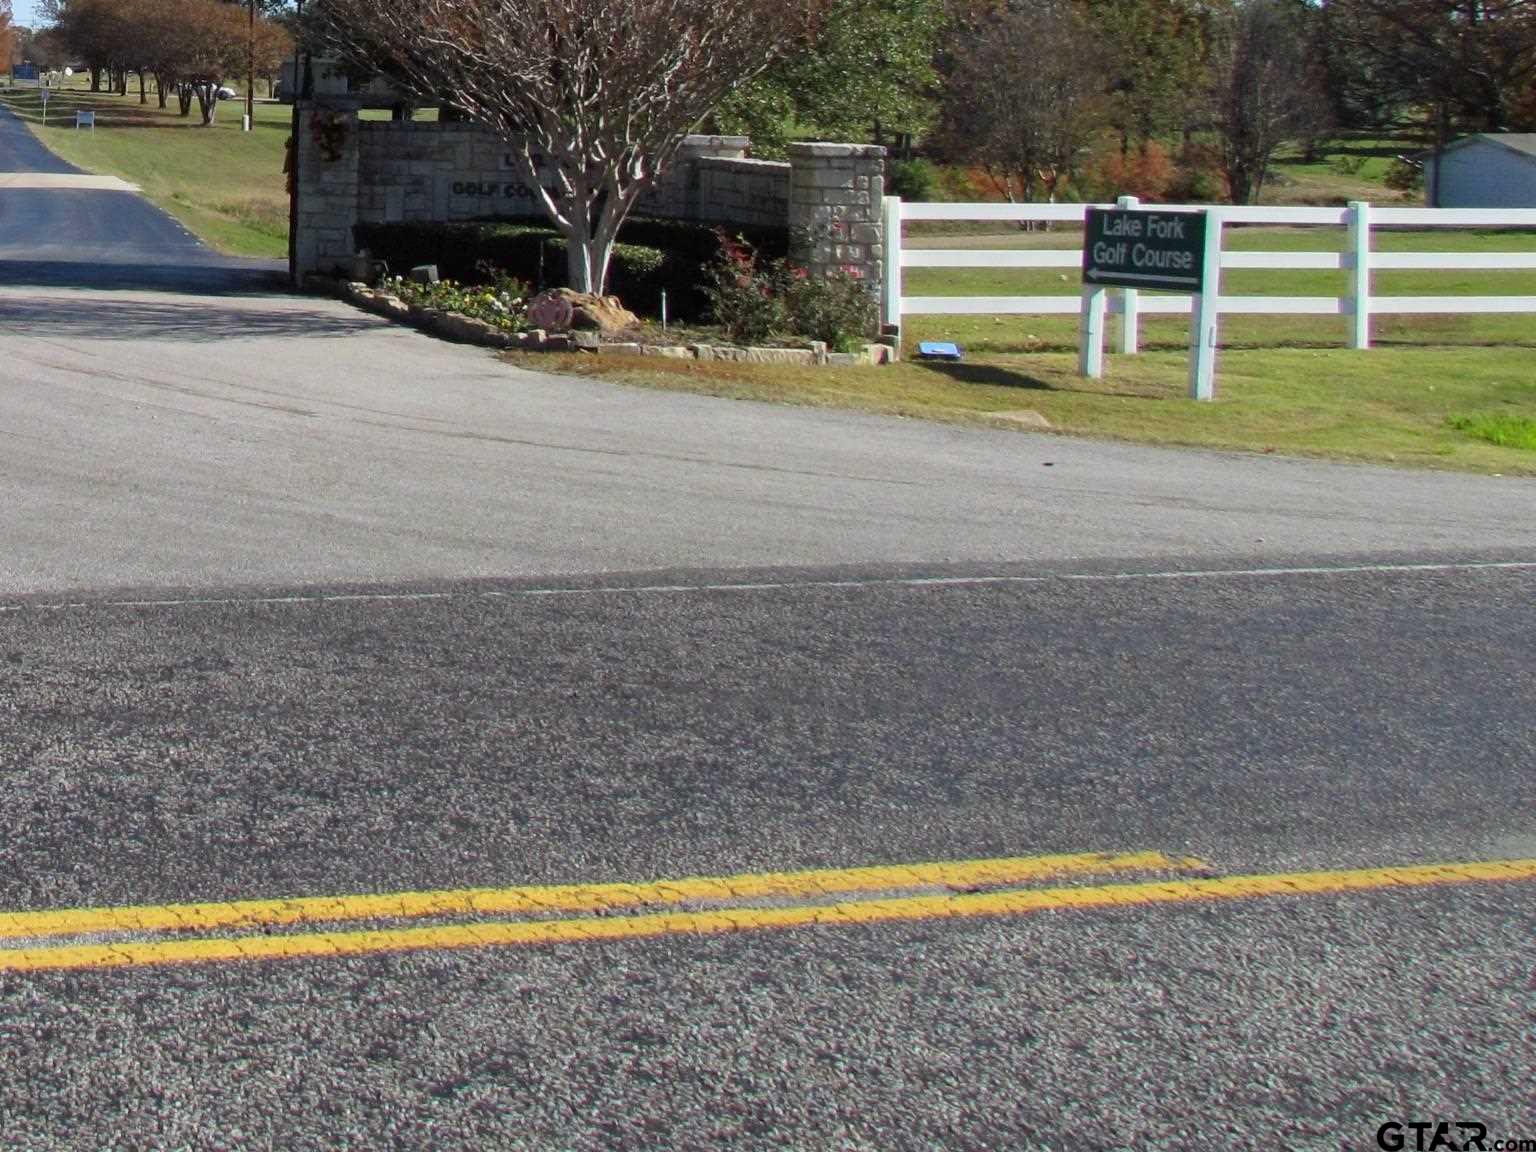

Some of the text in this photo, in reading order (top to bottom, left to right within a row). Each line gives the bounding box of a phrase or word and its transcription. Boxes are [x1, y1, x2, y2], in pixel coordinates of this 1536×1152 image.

[1102, 214, 1184, 239] Lake Fork
[1093, 241, 1193, 268] Golf Course
